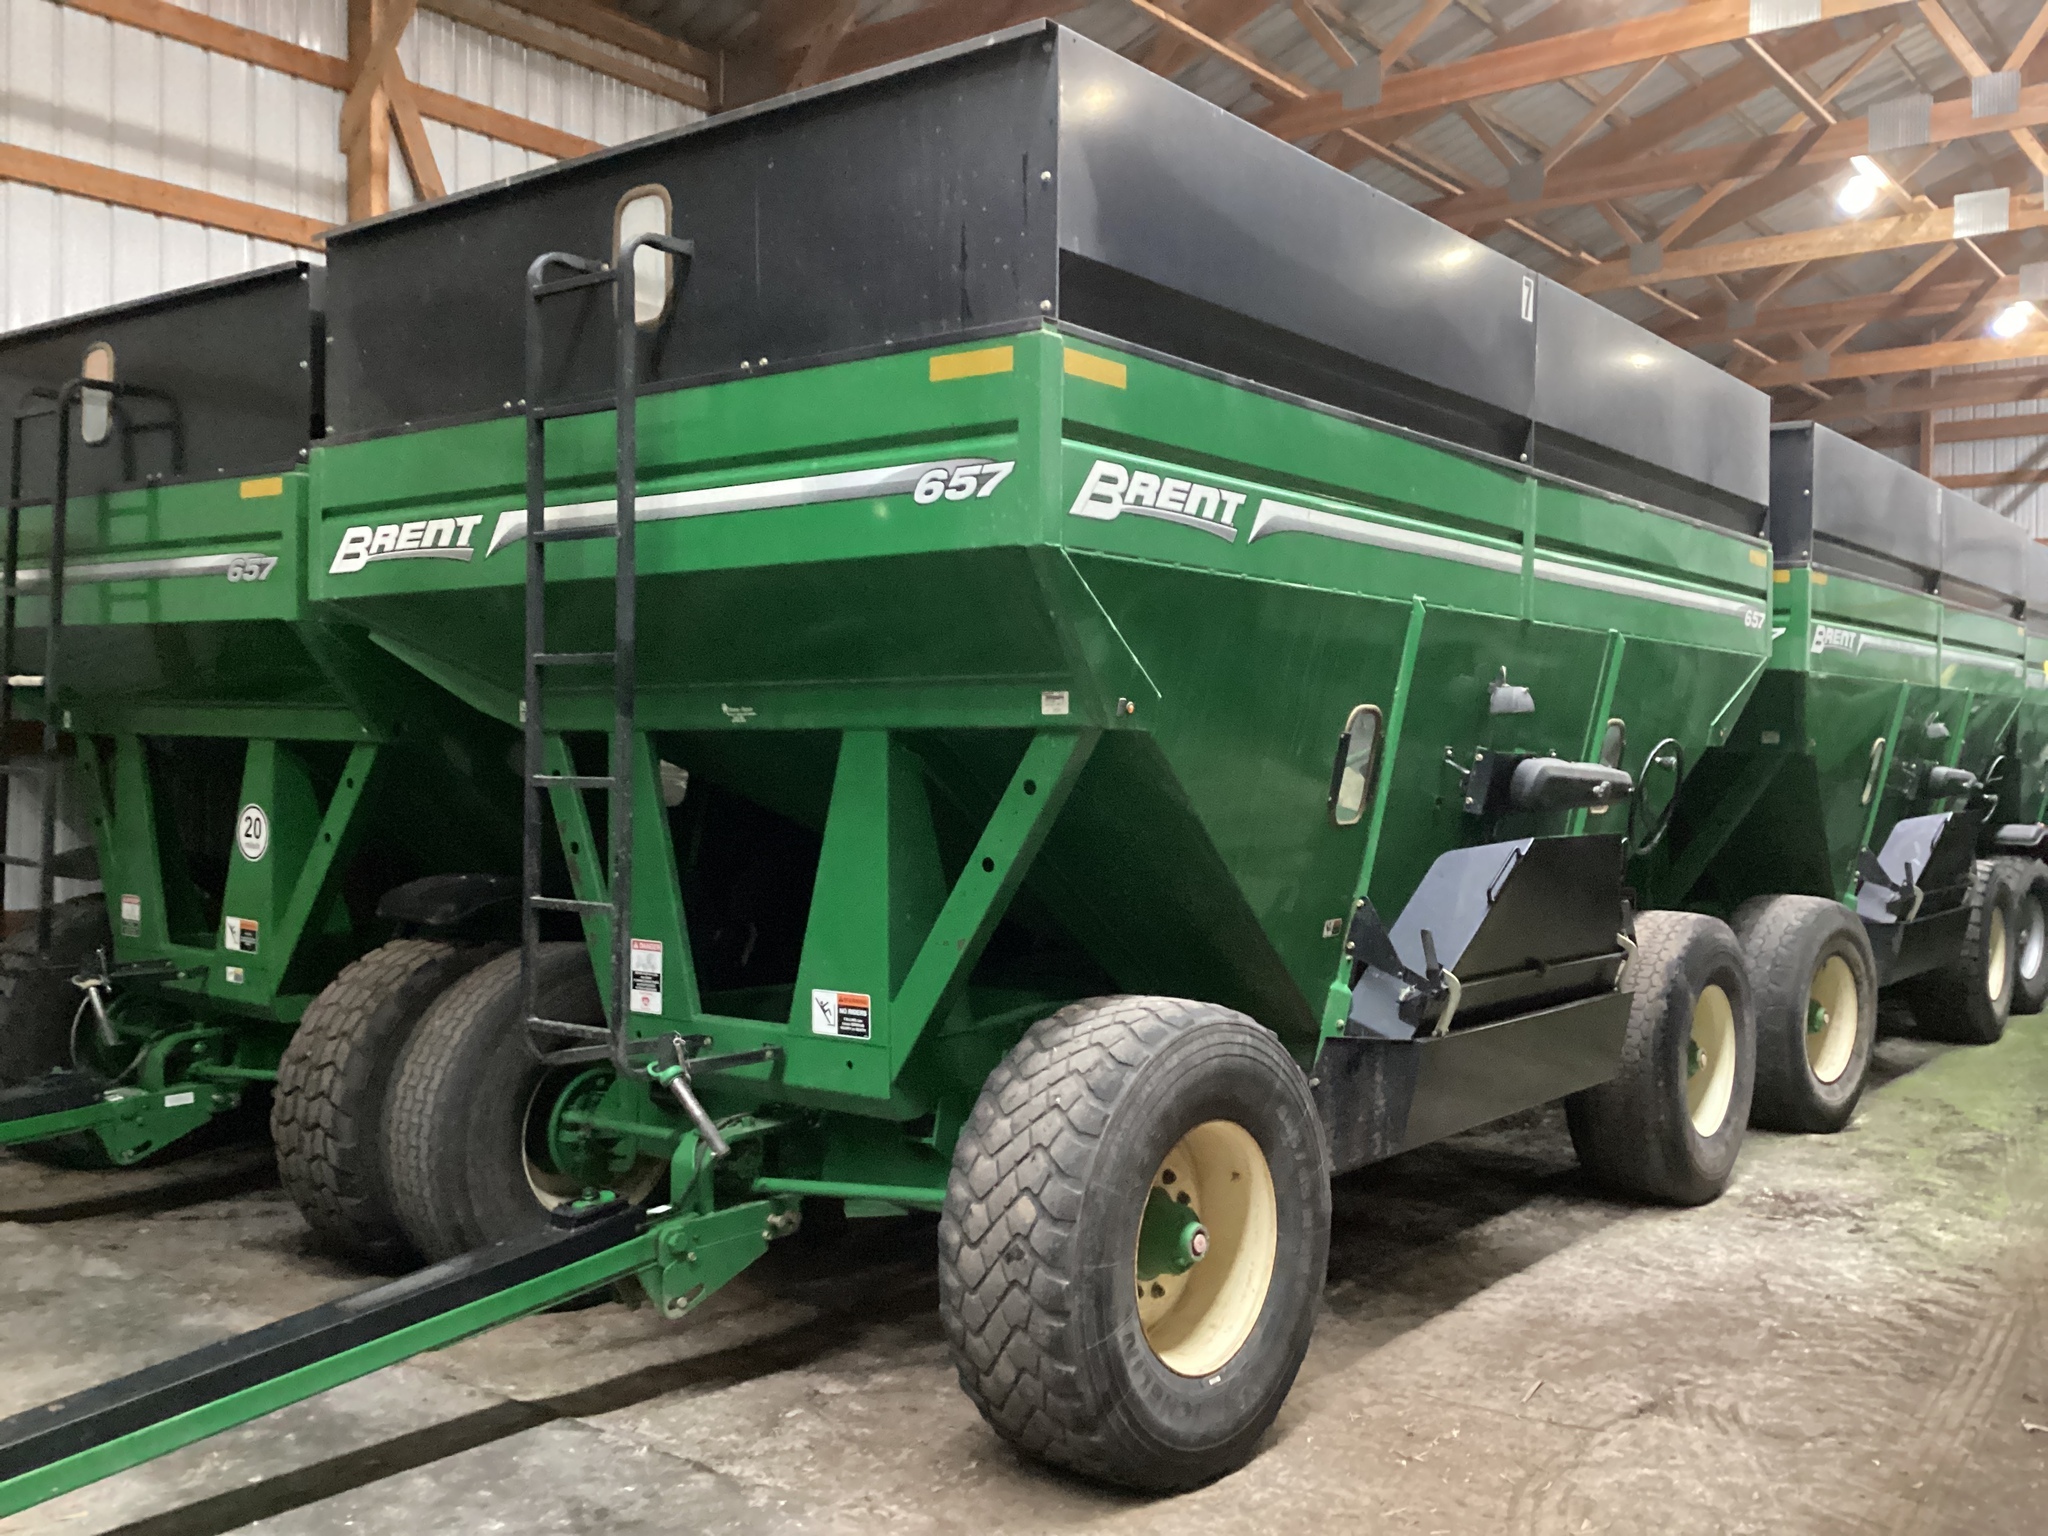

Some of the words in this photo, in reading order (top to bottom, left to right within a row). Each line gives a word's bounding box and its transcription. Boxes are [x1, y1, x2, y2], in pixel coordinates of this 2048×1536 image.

[914, 461, 1015, 504] 657
[1069, 460, 1247, 524] BRENT
[329, 515, 483, 574] BRENT
[228, 557, 279, 582] 657
[1744, 609, 1766, 629] 657
[1810, 624, 1857, 653] BRENT
[244, 816, 262, 839] 20
